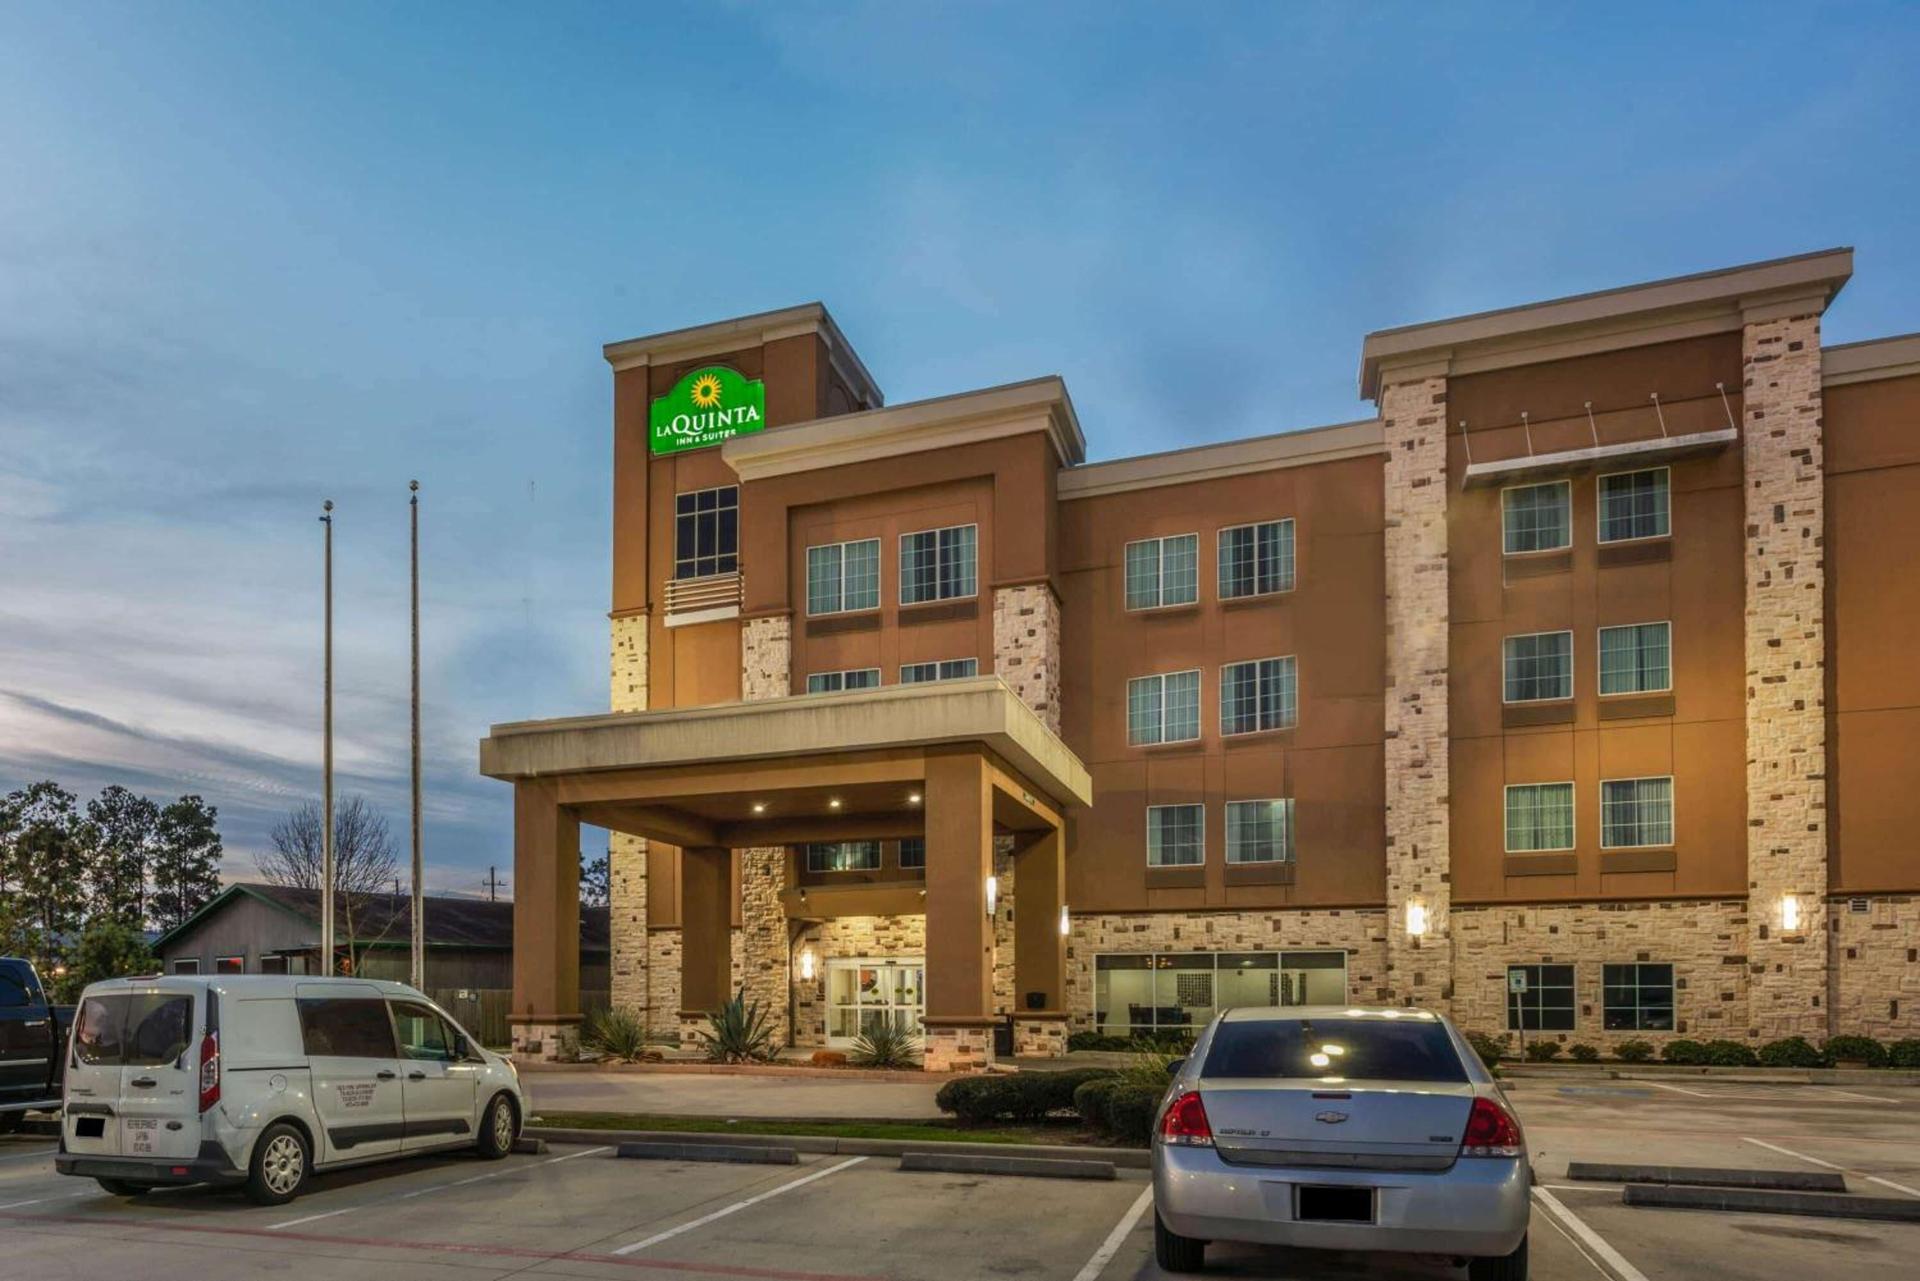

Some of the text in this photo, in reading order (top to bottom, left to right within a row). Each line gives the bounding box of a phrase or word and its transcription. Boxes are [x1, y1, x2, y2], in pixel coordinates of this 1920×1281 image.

[656, 405, 760, 437] LA QUINTA
[676, 436, 693, 446] INN
